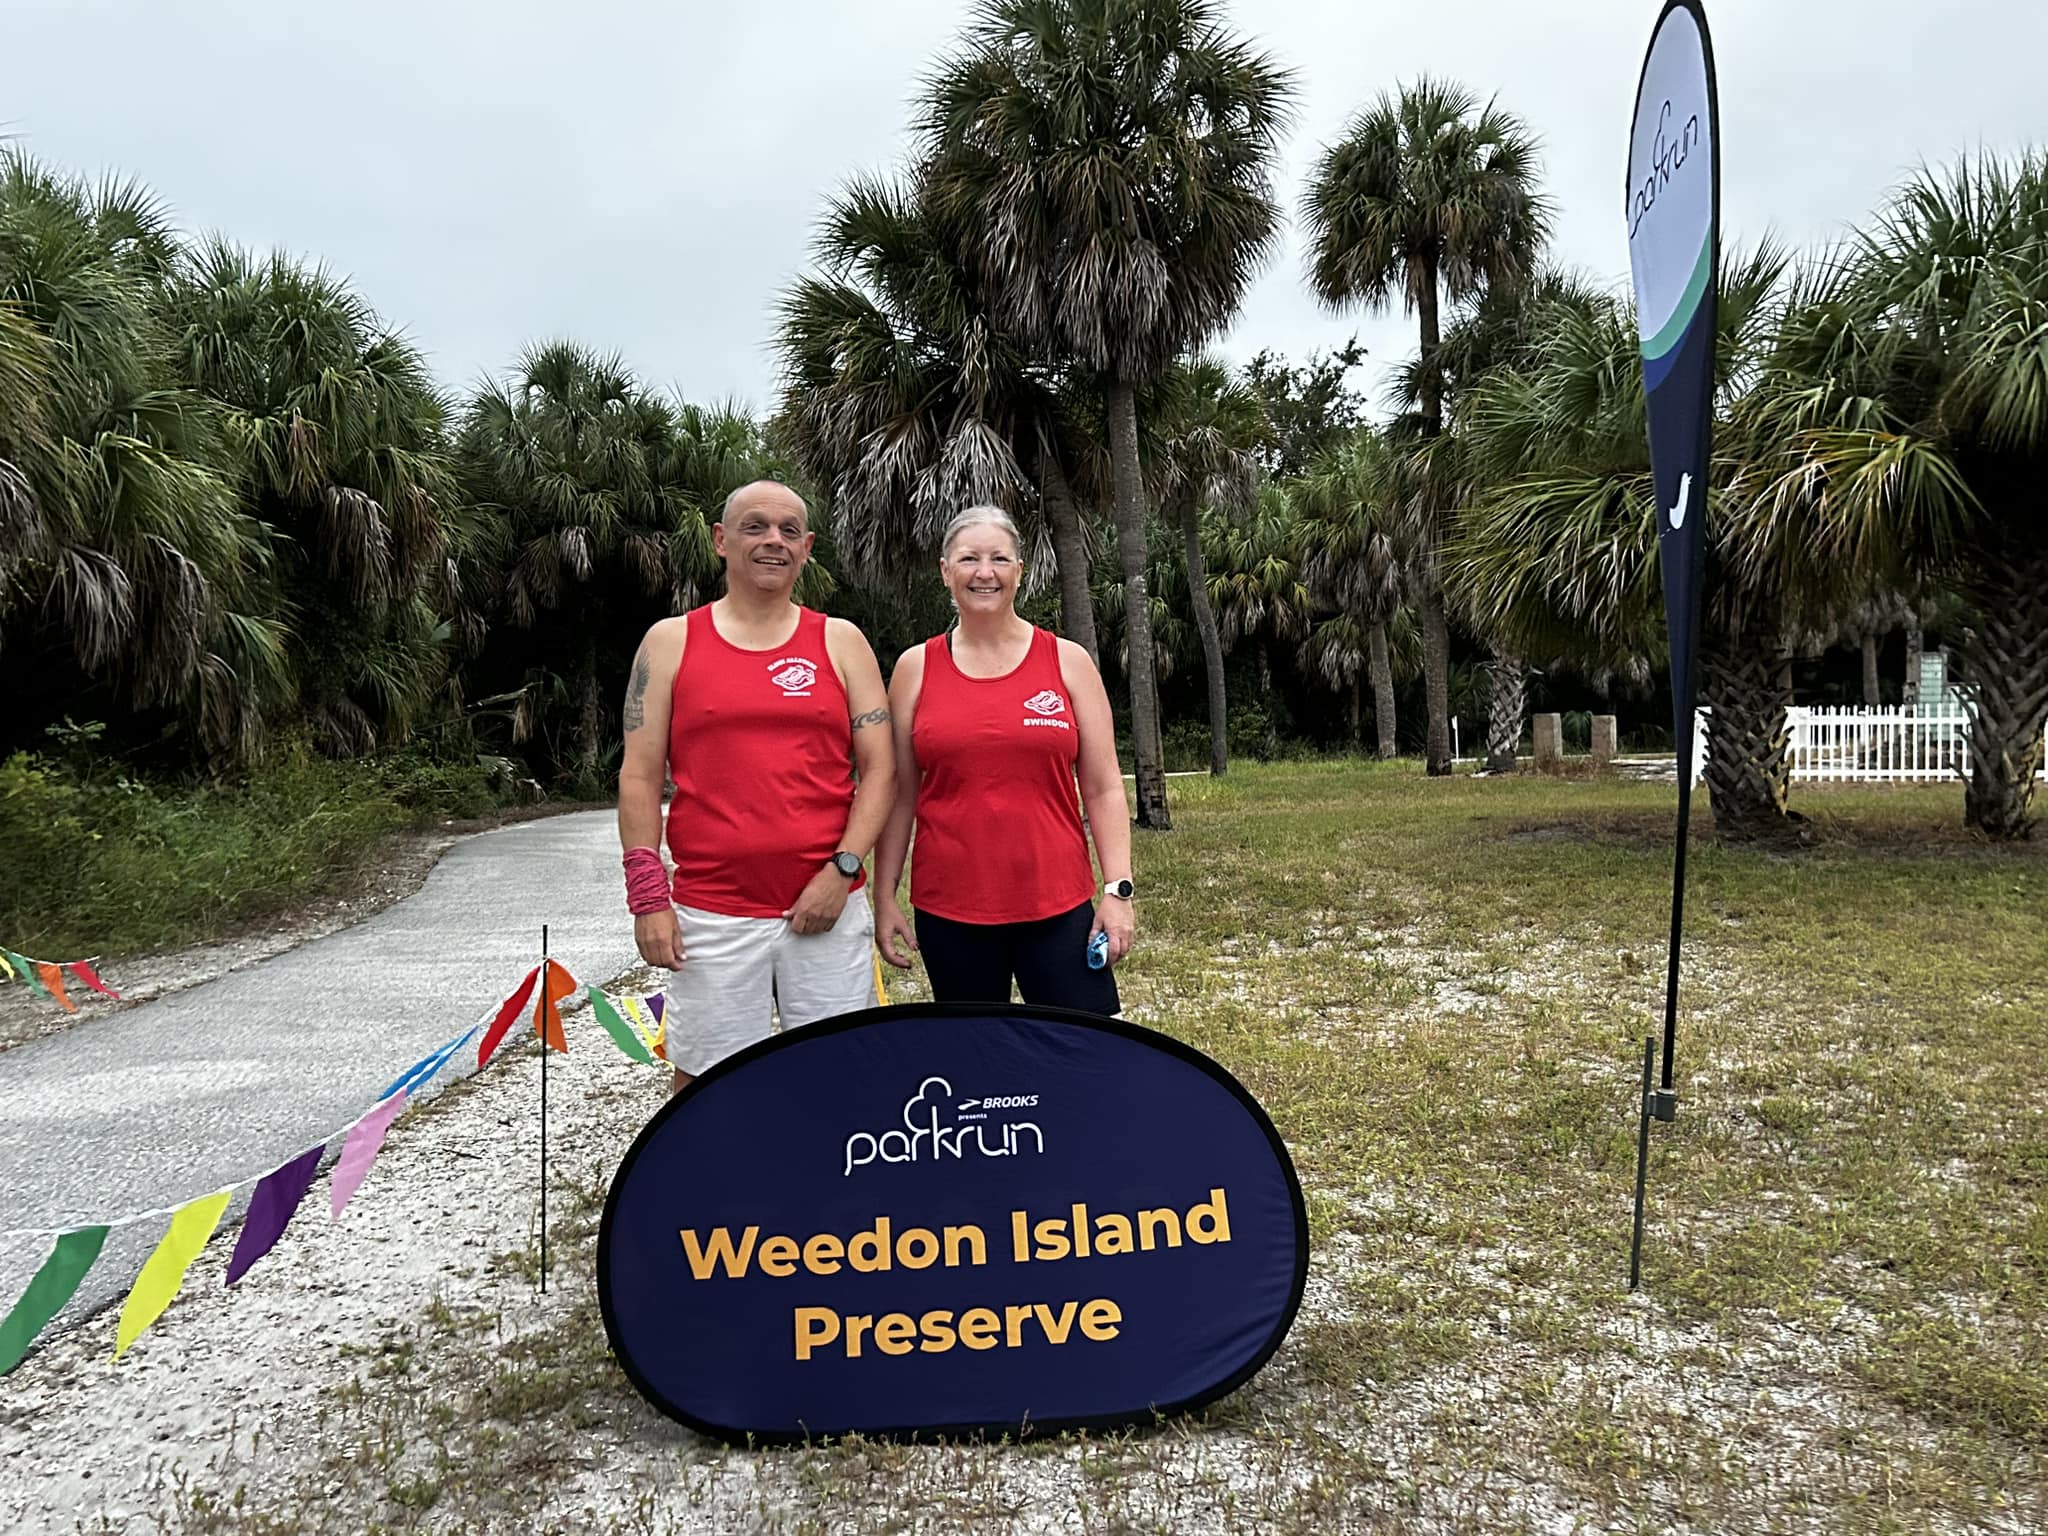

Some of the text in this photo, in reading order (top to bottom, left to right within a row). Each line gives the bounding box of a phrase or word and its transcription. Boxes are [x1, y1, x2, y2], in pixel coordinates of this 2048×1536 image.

[1630, 99, 1698, 240] parkrun
[1023, 718, 1070, 730] SWINDON
[844, 1076, 1044, 1177] parkrun
[958, 1113, 988, 1121] presents
[982, 1095, 1039, 1109] BROOKS
[680, 1188, 1232, 1280] Weedon Island
[794, 1298, 1122, 1361] Preserve
